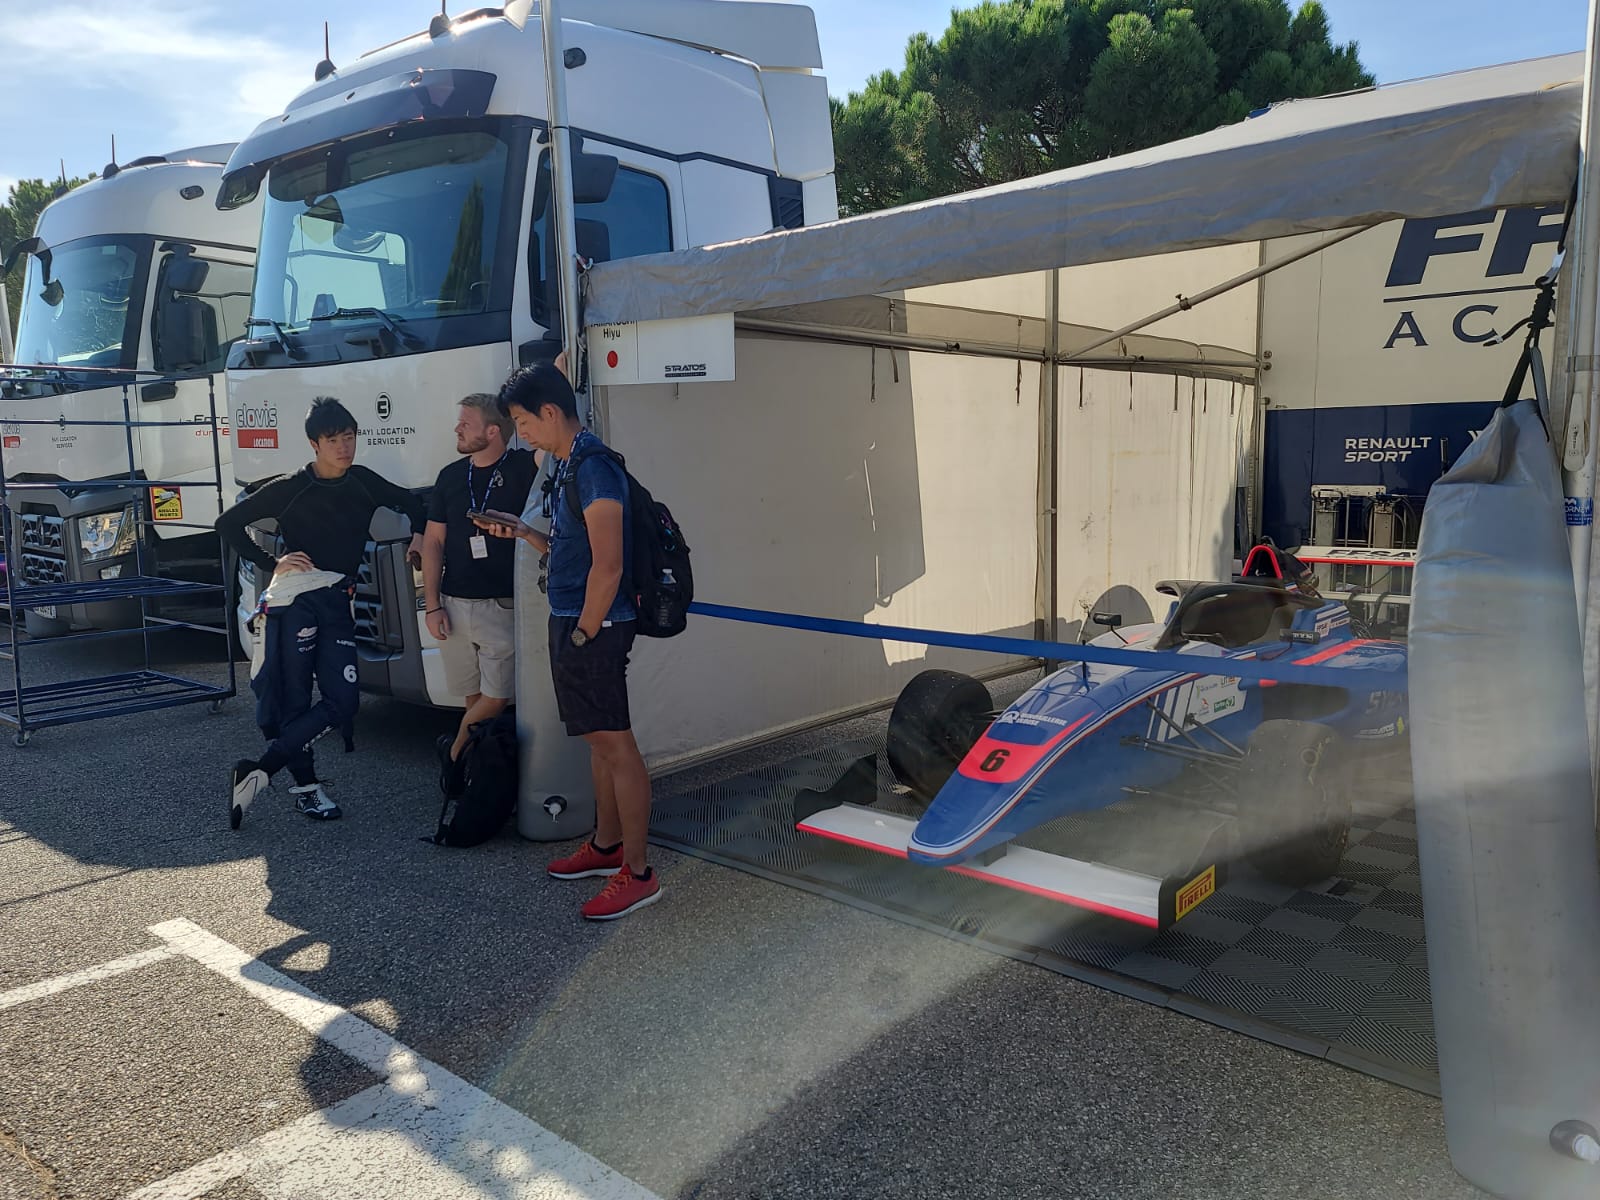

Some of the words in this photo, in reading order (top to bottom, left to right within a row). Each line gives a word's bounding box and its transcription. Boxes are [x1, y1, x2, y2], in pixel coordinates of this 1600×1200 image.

[603, 328, 621, 340] Hiyu
[664, 363, 707, 372] STRATOS
[236, 400, 278, 428] clovis
[376, 426, 416, 436] LOCATION
[367, 437, 406, 446] SERVICES
[1344, 436, 1433, 450] RENAULT
[1343, 450, 1412, 463] SPORT
[343, 664, 357, 683] 6
[980, 749, 1011, 773] 6
[1178, 872, 1213, 913] PIRELLI
